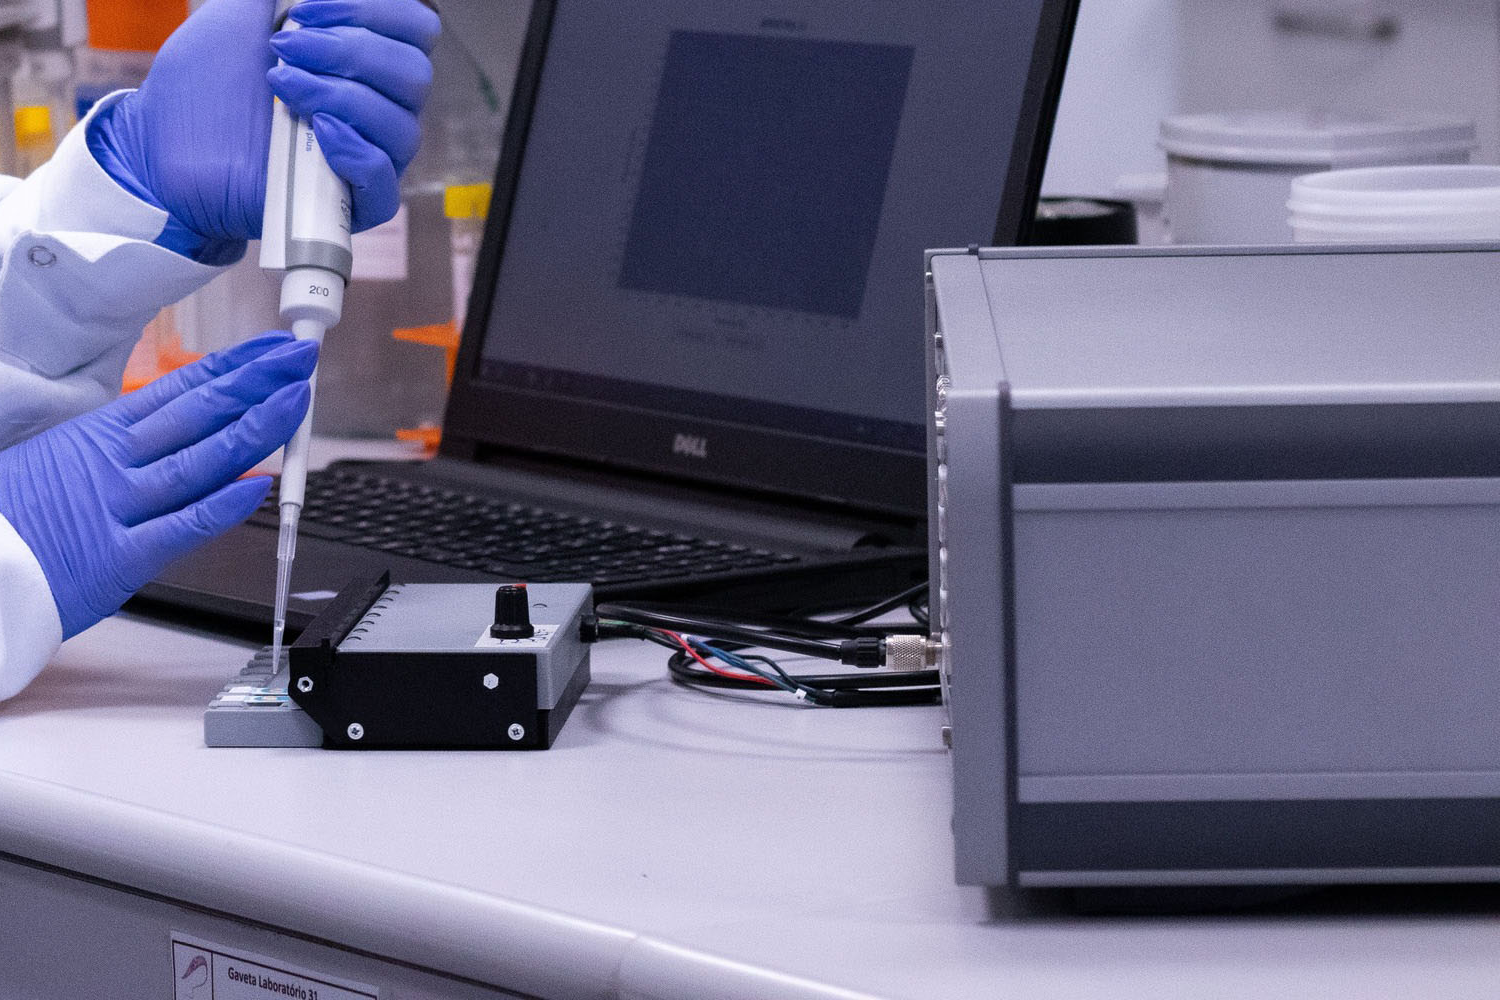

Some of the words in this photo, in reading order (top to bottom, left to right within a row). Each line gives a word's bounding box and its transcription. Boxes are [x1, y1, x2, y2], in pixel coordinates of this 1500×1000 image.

[305, 132, 314, 152] plus
[309, 285, 329, 297] 200
[674, 434, 707, 457] DELL
[227, 966, 257, 986] Gaveta
[258, 975, 306, 1000] Laboratório
[308, 988, 318, 1000] 31
